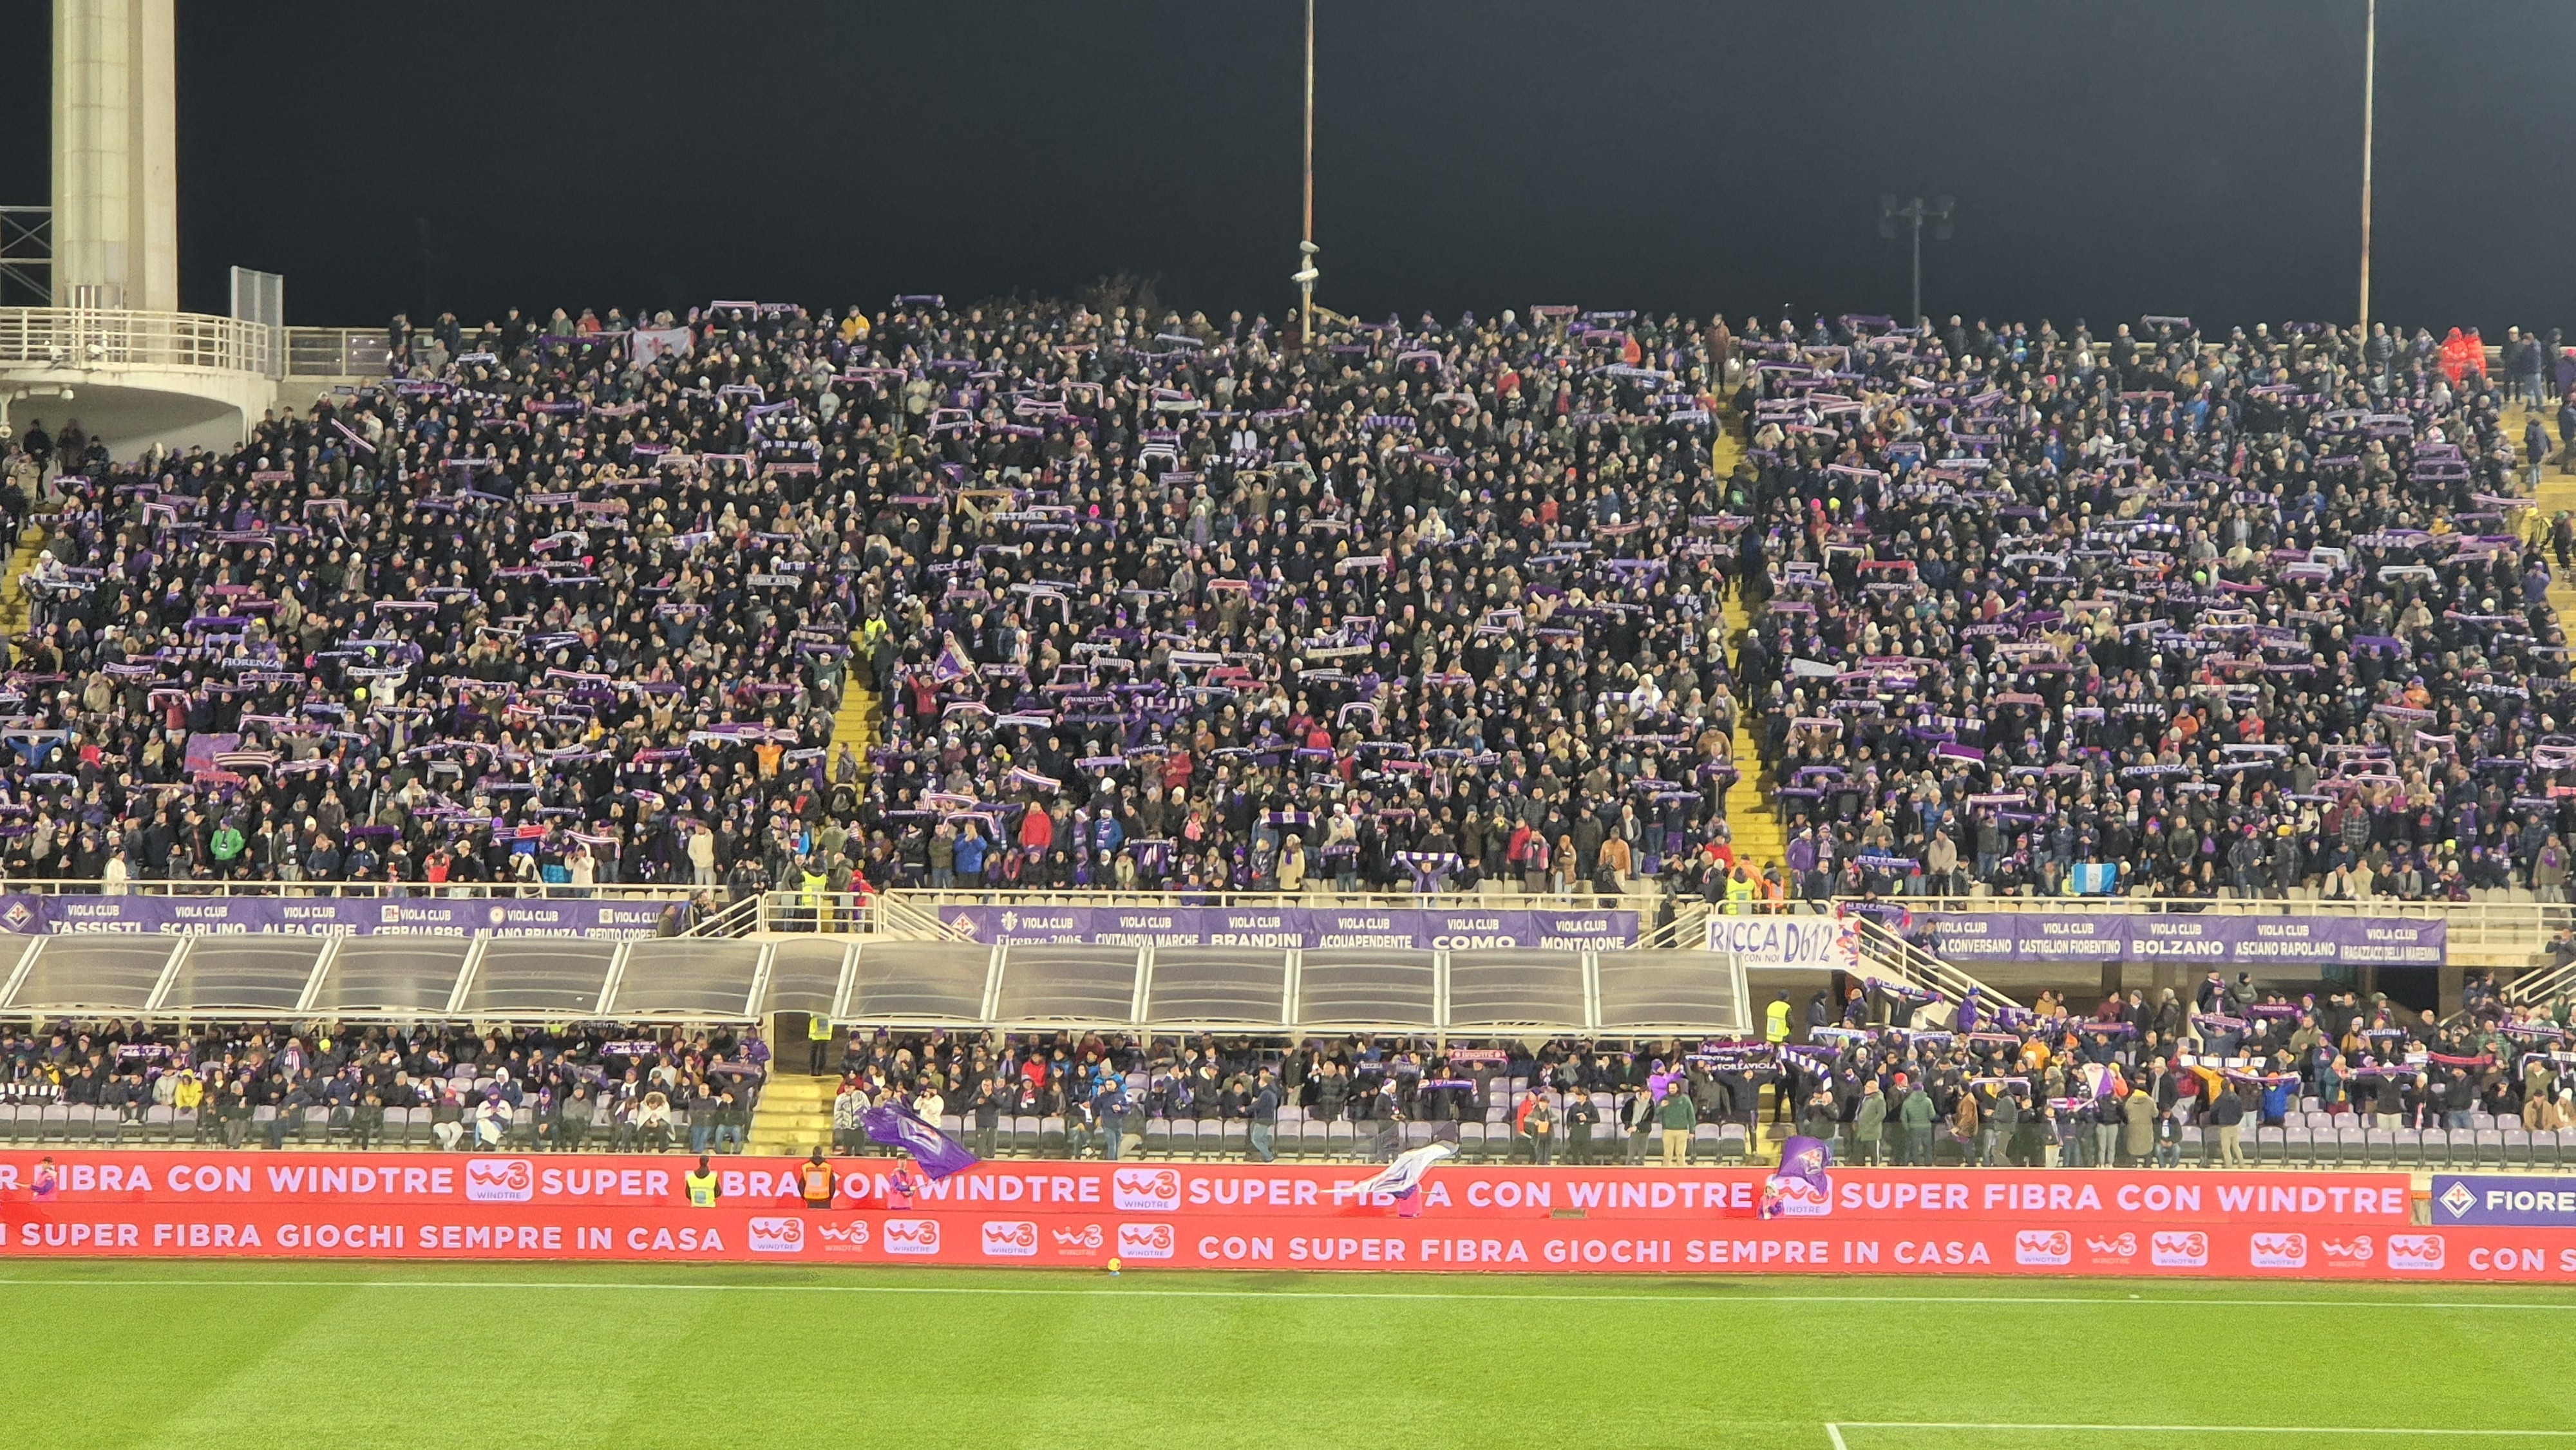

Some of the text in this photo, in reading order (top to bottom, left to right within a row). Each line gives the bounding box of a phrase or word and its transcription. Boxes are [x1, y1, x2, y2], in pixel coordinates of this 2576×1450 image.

[220, 658, 279, 668] FIORENZA
[2125, 764, 2188, 775] FIORENZA
[67, 905, 120, 917] VIOLA CLUB
[175, 906, 227, 918] VIOLA CLUB
[283, 907, 336, 918] VIOLA CLUB
[401, 909, 451, 921] VIOLA CLUB
[507, 910, 559, 921] VIOLA CLUB
[614, 912, 658, 923] VIOLA CLU
[1023, 917, 1074, 928] VIOLA CLUB
[1119, 916, 1171, 928] VIOLA CLUB
[1229, 917, 1280, 929] VIOLA CLUB
[1338, 918, 1390, 929] VIOLA CLUB
[49, 920, 142, 934] TASSISTI
[160, 923, 247, 936] SCARLINO
[262, 923, 357, 937] ALFA CURE
[1448, 919, 1499, 930] VIOLA CLUB
[1556, 920, 1607, 932] VIOLA CLUB
[1937, 922, 1987, 933] VIOLA CLUB
[2043, 923, 2094, 934] VIOLA CLUB
[2151, 924, 2202, 936] VIOLA CLUB
[2257, 925, 2309, 936] VIOLA CLUB
[475, 928, 522, 938] MILANO
[585, 928, 621, 939] CREDITO
[1710, 921, 1780, 952] RICCA
[2367, 928, 2418, 940] VIOLA CLUB
[997, 934, 1082, 945] Firenze 2005
[1095, 934, 1199, 947] CIVITANOVA MARCHE
[1211, 934, 1303, 948] BRANDINI
[1320, 935, 1412, 949] ACQUAPENDENTE
[1432, 936, 1516, 950] COMO
[1541, 936, 1626, 951] MONTAIONE
[1948, 939, 2012, 954] CONVERSANO
[2020, 939, 2121, 954] CASTIGLION FIORENTINO
[2133, 940, 2224, 955] BOLZANO
[2235, 941, 2336, 956] ASCIANO RAPOLANO
[1744, 954, 1780, 963] CON NOI
[2384, 946, 2405, 961] DELLA
[168, 1165, 251, 1192] CON
[267, 1167, 453, 1193] WINDTRE
[542, 1169, 668, 1195] SUPER
[915, 1174, 1100, 1202] WINDTRE
[1189, 1178, 1316, 1205] SUPER
[1468, 1182, 1551, 1207] CON
[1567, 1182, 1752, 1209] WINDTRE
[1841, 1183, 2403, 1214] SUPER FIBRA CON WINDTRE
[23, 1223, 138, 1246] SUPER
[155, 1224, 261, 1247] FIBRA
[277, 1225, 403, 1248] GIOCHI
[420, 1226, 562, 1249] SEMPRE
[578, 1227, 612, 1249] IN
[628, 1228, 724, 1251] CASA
[1199, 1237, 1991, 1265] CON SUPER FIBRA GIOCHI SEMPRE IN CASA
[2469, 1248, 2544, 1271] CON
